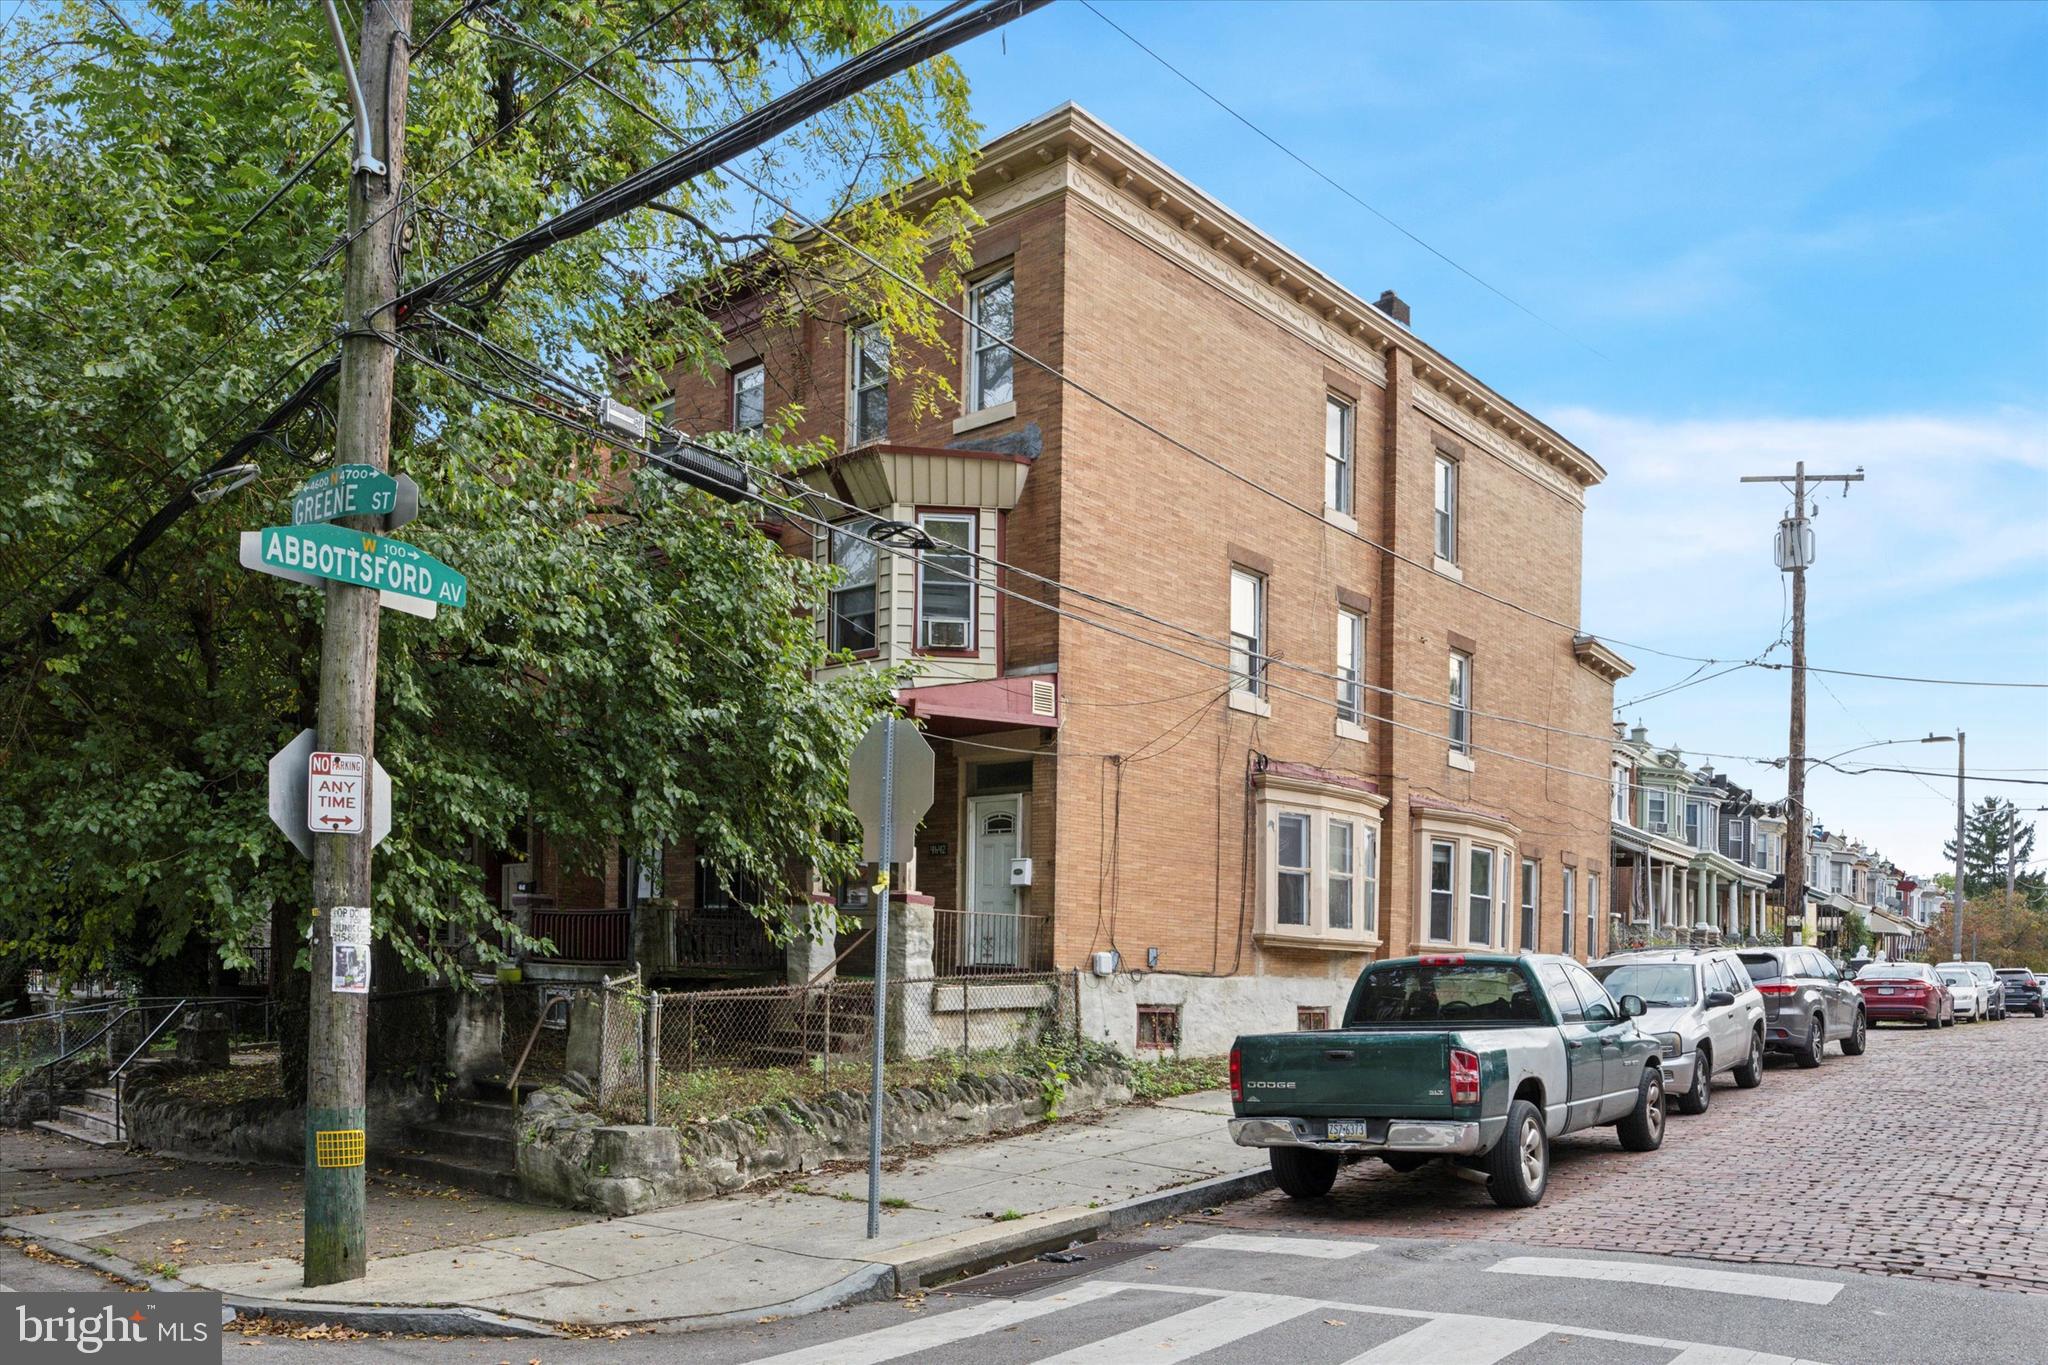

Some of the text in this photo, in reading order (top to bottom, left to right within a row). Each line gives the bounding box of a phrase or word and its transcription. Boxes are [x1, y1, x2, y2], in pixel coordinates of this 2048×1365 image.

[310, 469, 368, 491] 4600 N 4700
[295, 484, 391, 526] GREENE ST
[362, 536, 407, 558] W 100
[266, 531, 462, 602] ABBOTTSFORD AV
[313, 756, 361, 772] NO PARKING
[319, 780, 356, 793] ANY
[318, 795, 356, 809] TIME
[1247, 1081, 1296, 1089] DODGE
